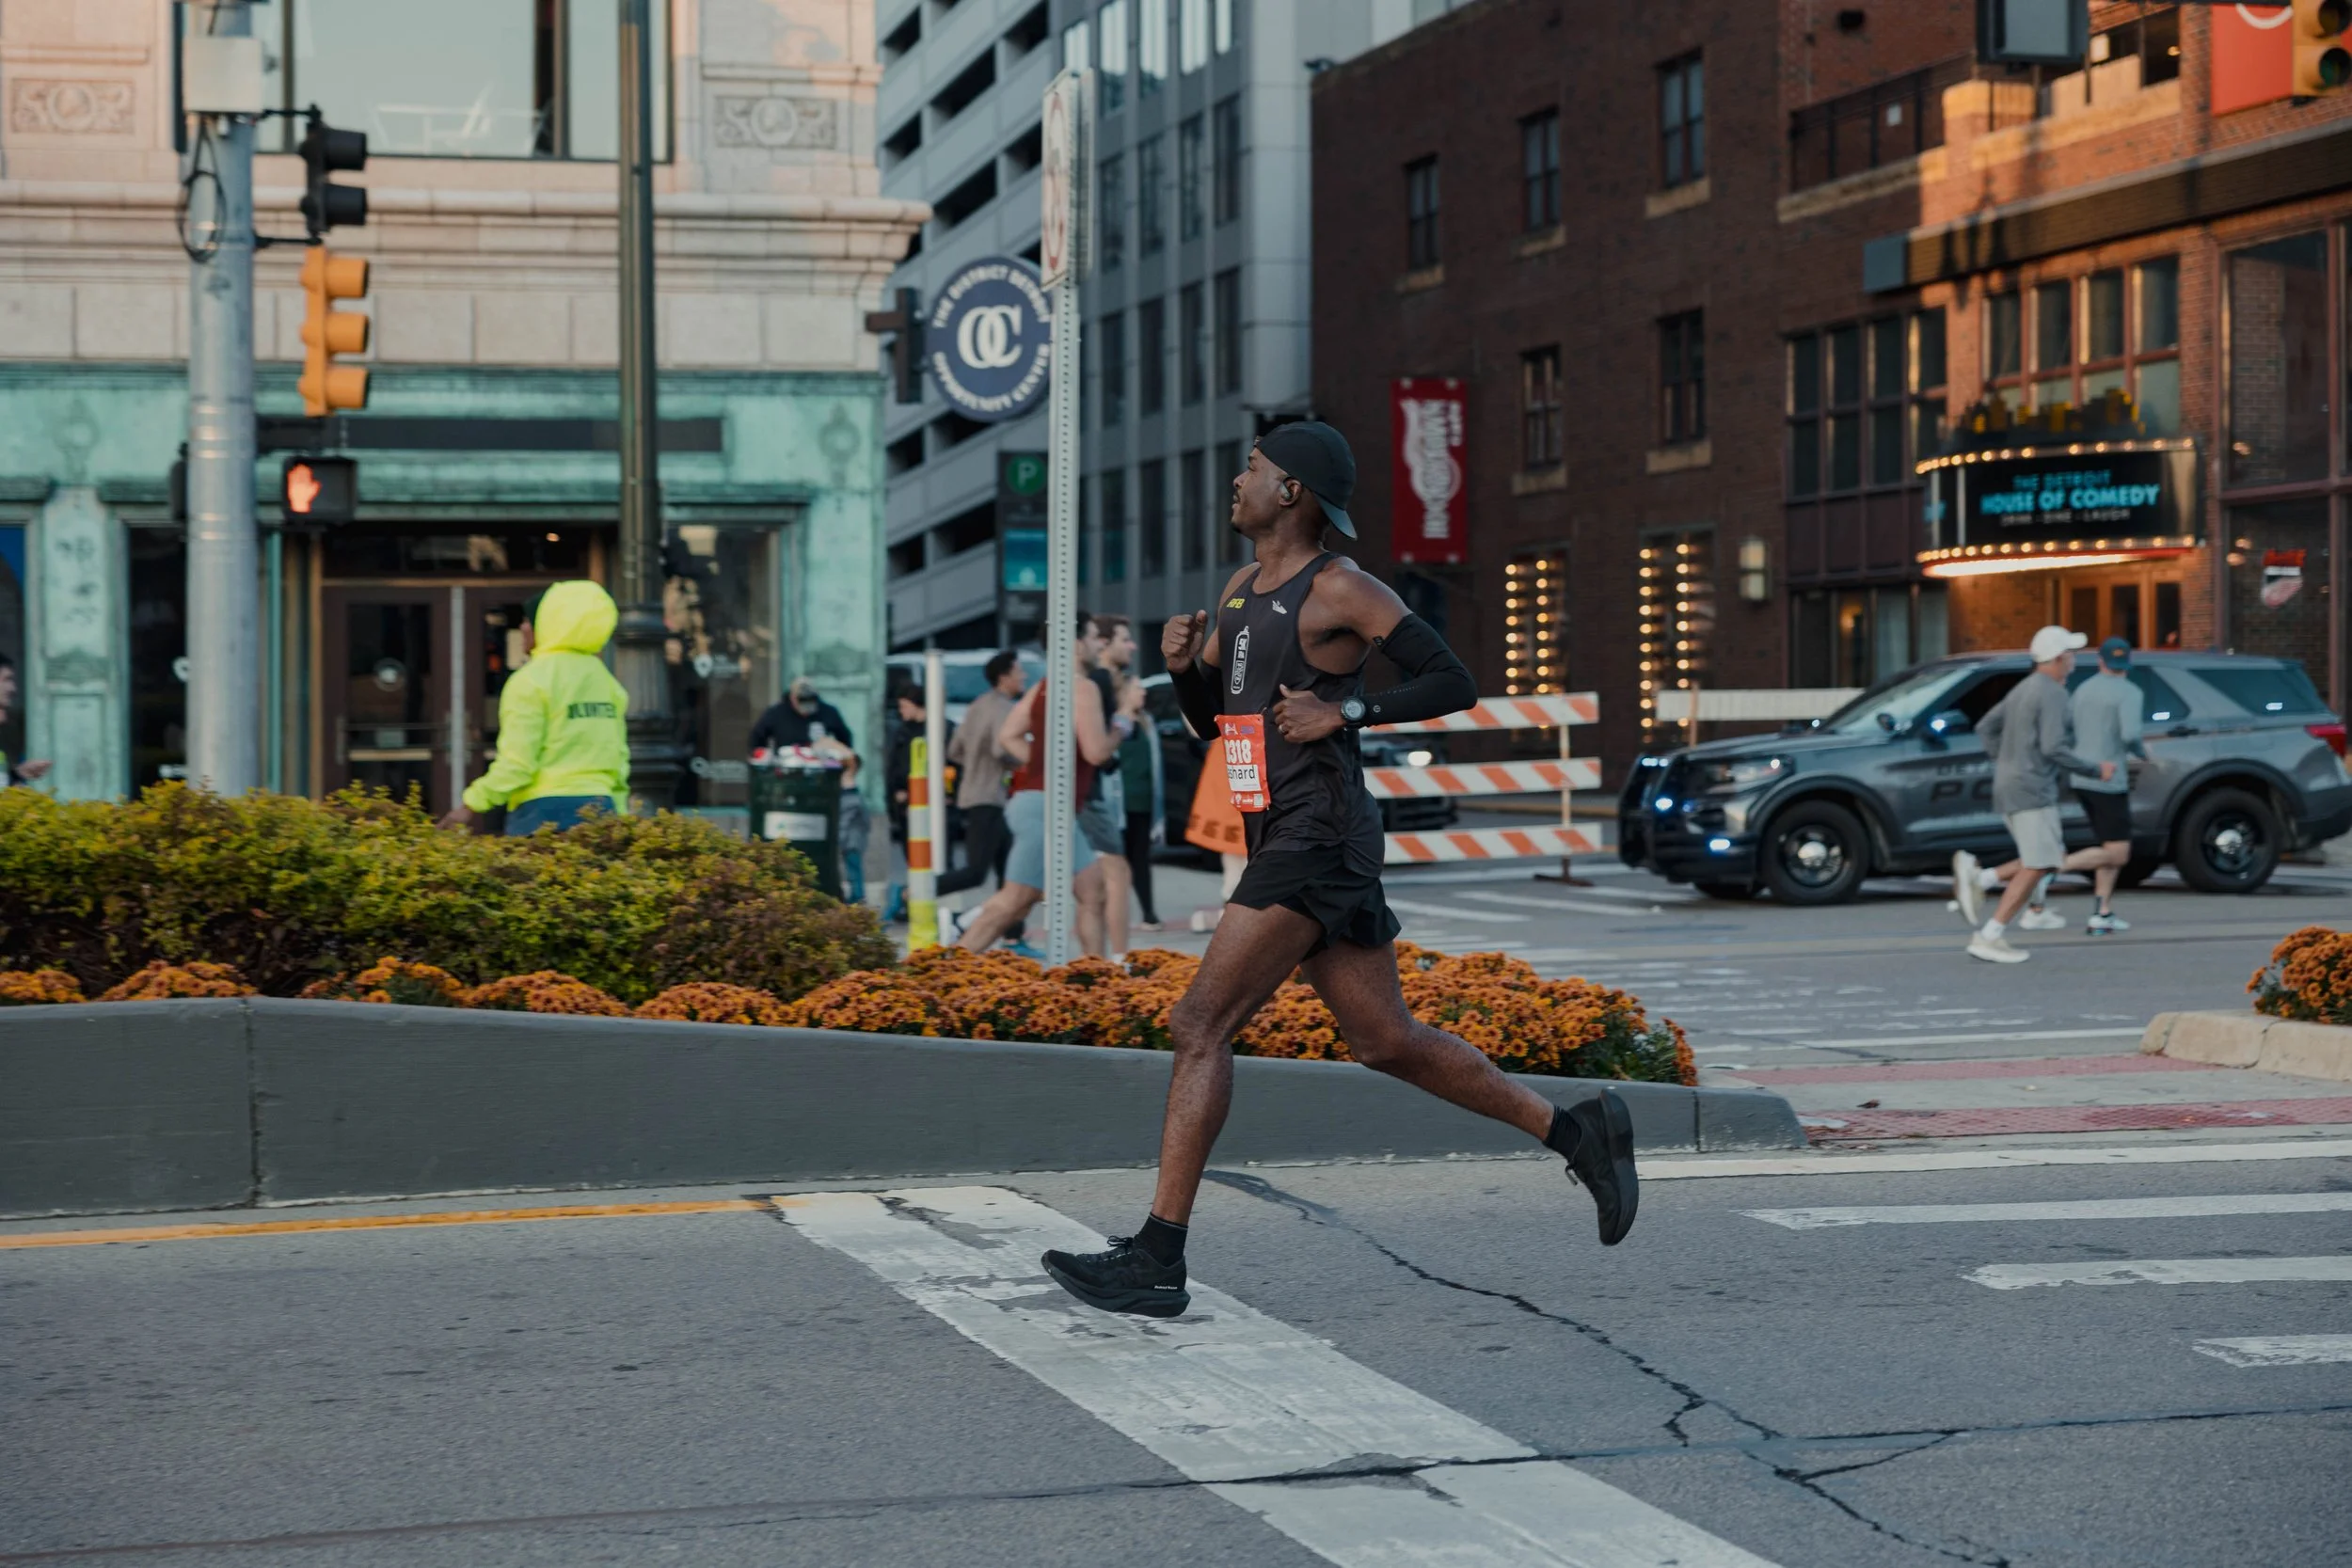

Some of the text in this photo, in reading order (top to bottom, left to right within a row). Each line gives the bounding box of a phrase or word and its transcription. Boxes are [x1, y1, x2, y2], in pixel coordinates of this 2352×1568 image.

[932, 297, 955, 327] THE
[948, 264, 1009, 299] DISTRICT
[957, 304, 1023, 369] OC
[932, 343, 1050, 412] OPPORTUNITY CENTER
[1017, 461, 1038, 489] P
[2013, 470, 2111, 490] THE DETROIT
[1981, 483, 2160, 515] HOUSE OF COMEDY
